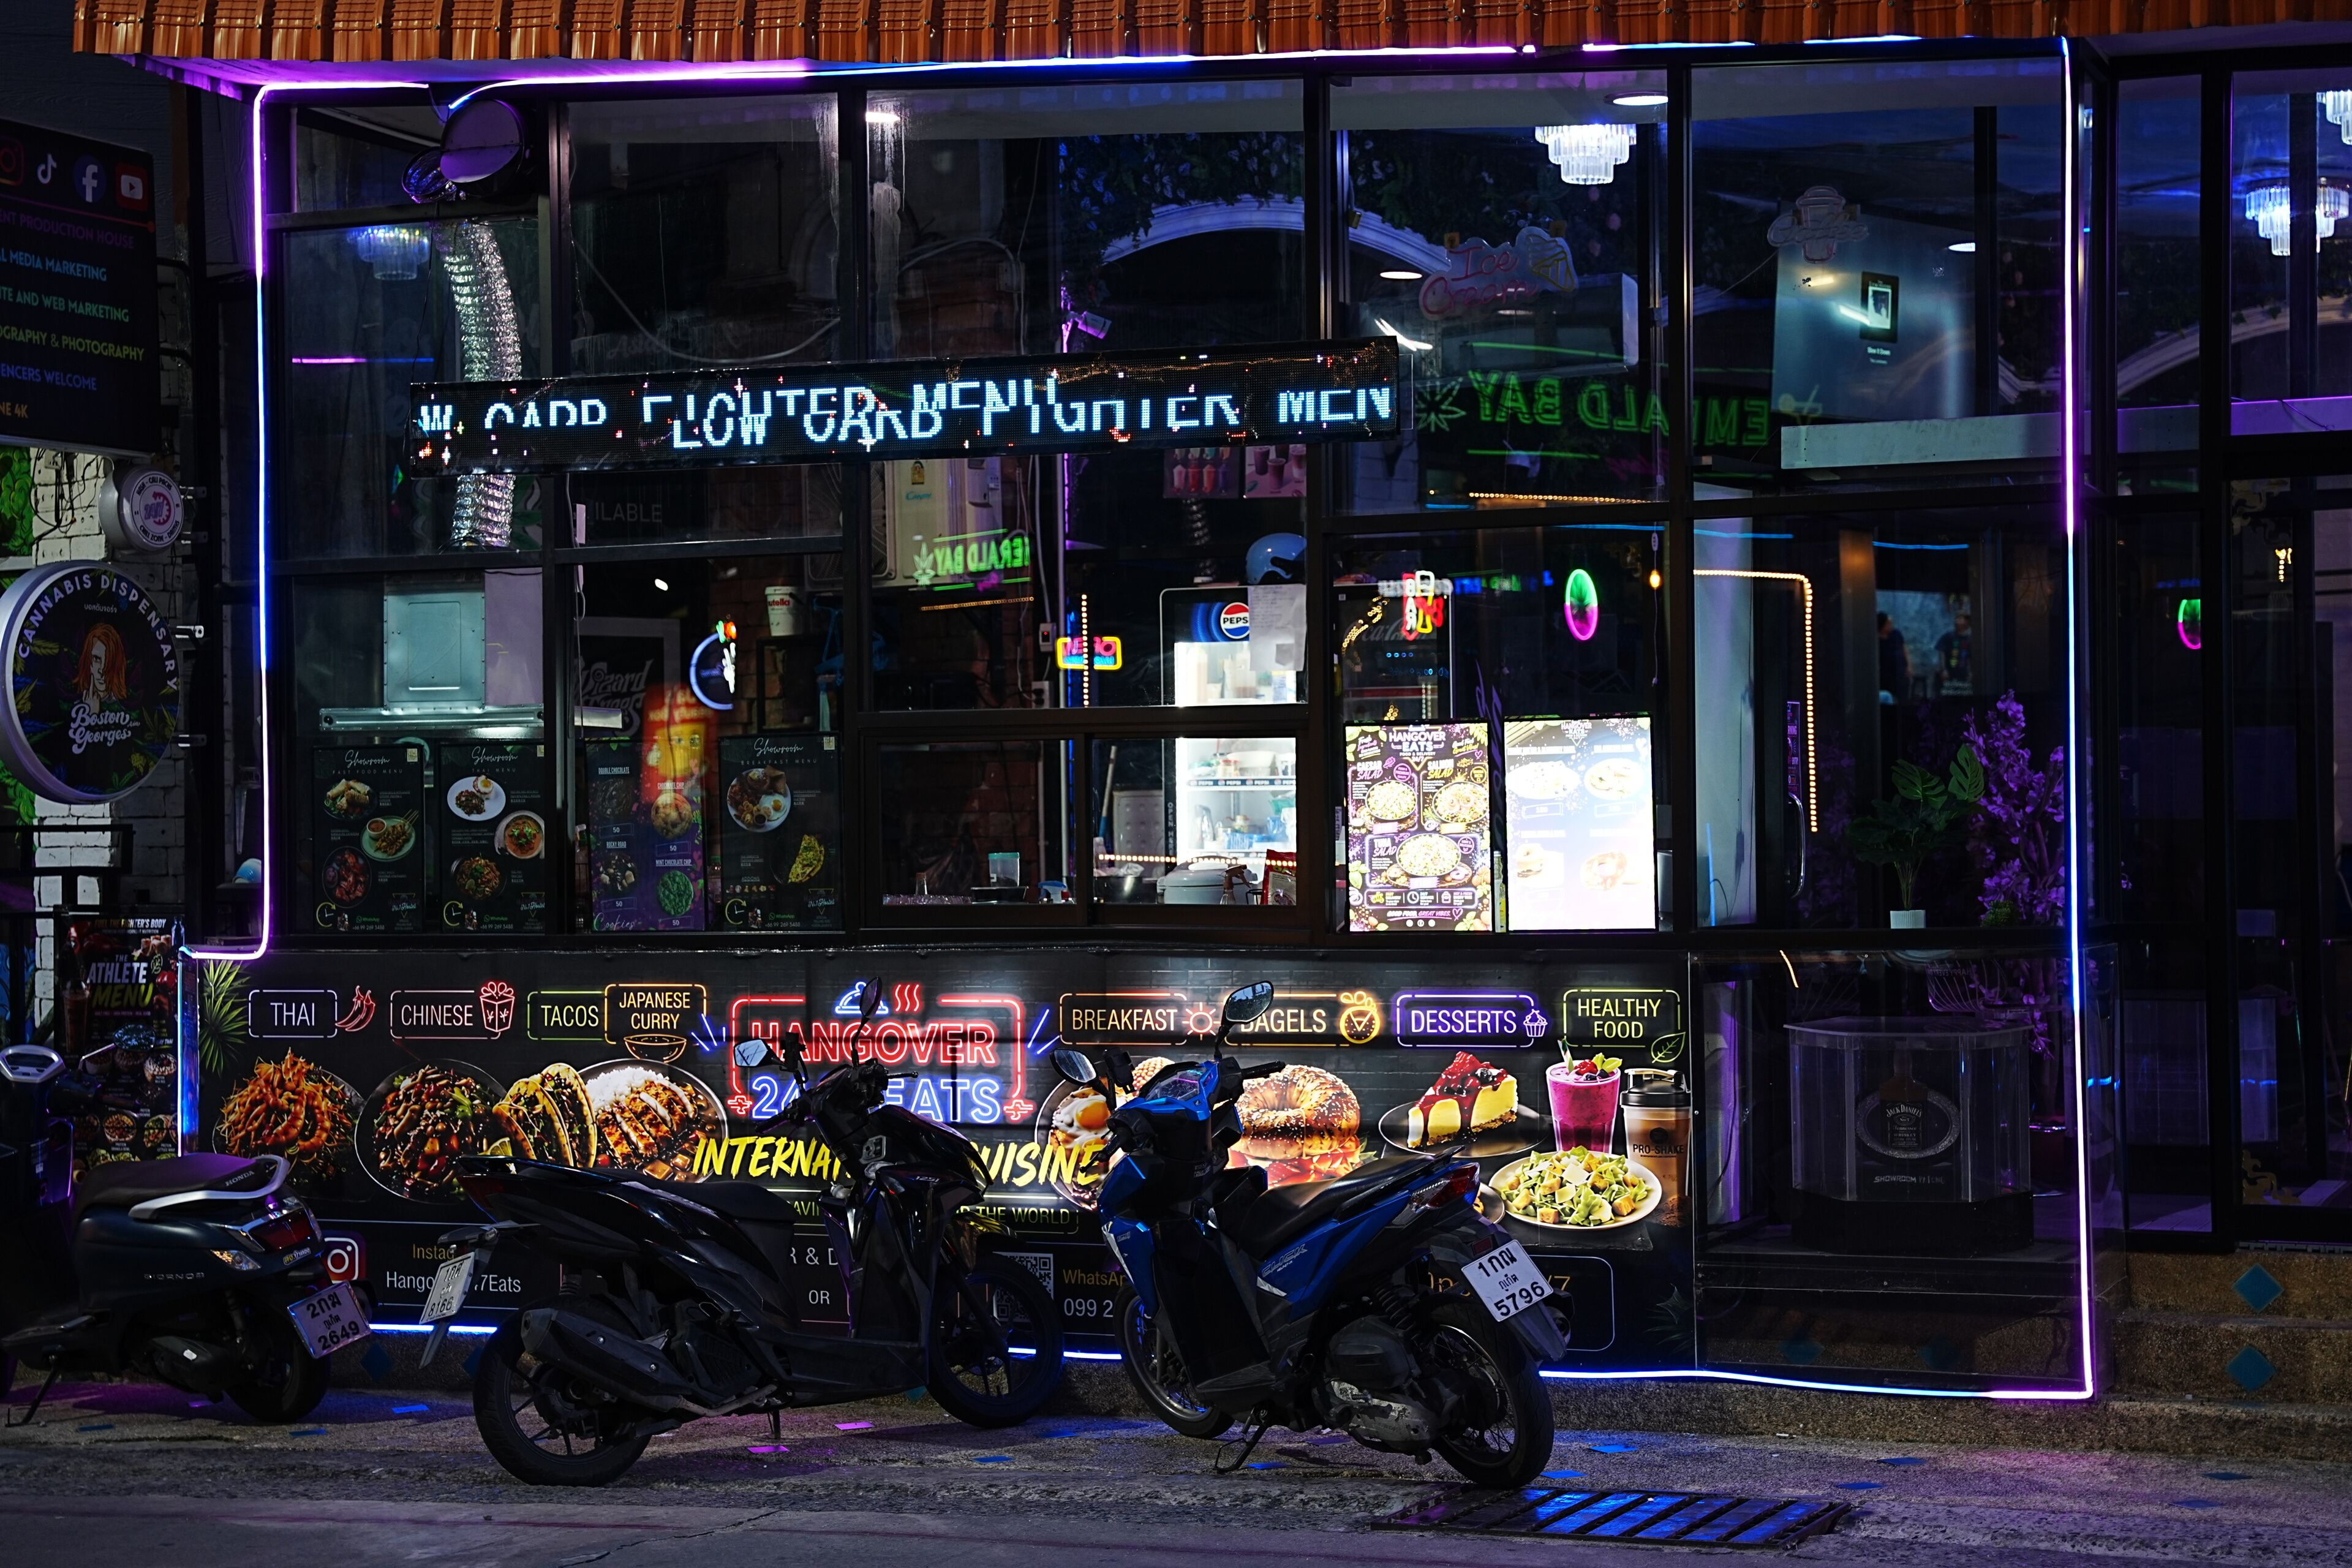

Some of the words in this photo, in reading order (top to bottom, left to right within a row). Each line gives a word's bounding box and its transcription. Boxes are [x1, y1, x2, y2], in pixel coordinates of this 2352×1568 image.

[20, 215, 93, 241] PRODUCTION
[97, 230, 135, 249] HOUSE
[9, 250, 43, 270] MEDIA
[45, 257, 107, 282] MARKETING
[1449, 246, 1520, 281] Ice
[1423, 276, 1539, 314] Cream
[16, 290, 39, 306] AND
[42, 293, 65, 312] WEB
[69, 300, 129, 323] MARKETING
[51, 333, 59, 349] &
[62, 336, 145, 362] PHOTOGRAPHY
[45, 369, 97, 391] WELCOME
[14, 404, 28, 419] 4K
[18, 573, 92, 659] CANNABIS
[100, 574, 179, 692] DISPENSARY
[70, 703, 130, 729] Boston
[69, 726, 131, 755] Georges
[754, 737, 803, 756] Showroom
[1389, 731, 1446, 742] HANGOVER
[1402, 741, 1433, 752] EATS
[345, 750, 390, 768] Showroom
[472, 745, 518, 765] Showroom
[1357, 761, 1382, 771] CAESAR
[1357, 769, 1383, 780] SALAD
[1427, 768, 1453, 779] SALAD
[1373, 846, 1397, 857] SALAD
[151, 919, 166, 928] BODY
[594, 912, 635, 931] Cookies
[86, 962, 148, 984] ATHLETE
[92, 982, 153, 1009] MENU
[619, 992, 690, 1009] JAPANESE
[270, 1002, 315, 1025] THAI
[401, 1005, 473, 1026] CHINESE
[541, 1005, 599, 1027] TACOS
[1577, 998, 1661, 1018] HEALTHY
[631, 1012, 679, 1030] CURRY
[1072, 1009, 1178, 1031] BREAKFAST
[1240, 1009, 1327, 1032] BAGELS
[1411, 1009, 1517, 1034] DESSERTS
[1594, 1021, 1643, 1038] FOOD
[752, 1022, 995, 1065] HANGOVER
[1632, 1144, 1684, 1155] PRO-SHAKE
[969, 1139, 1104, 1188] UISINE
[225, 1170, 255, 1186] HONDA
[979, 1207, 1006, 1222] THE
[1012, 1207, 1070, 1224] WORLD
[805, 1247, 820, 1265] &
[1063, 1269, 1126, 1287] WhatsAp
[429, 1297, 454, 1317] 8166
[809, 1289, 830, 1305] OR
[1494, 1281, 1545, 1317] 5796
[1064, 1298, 1097, 1318] 099
[318, 1321, 360, 1351] 2649
